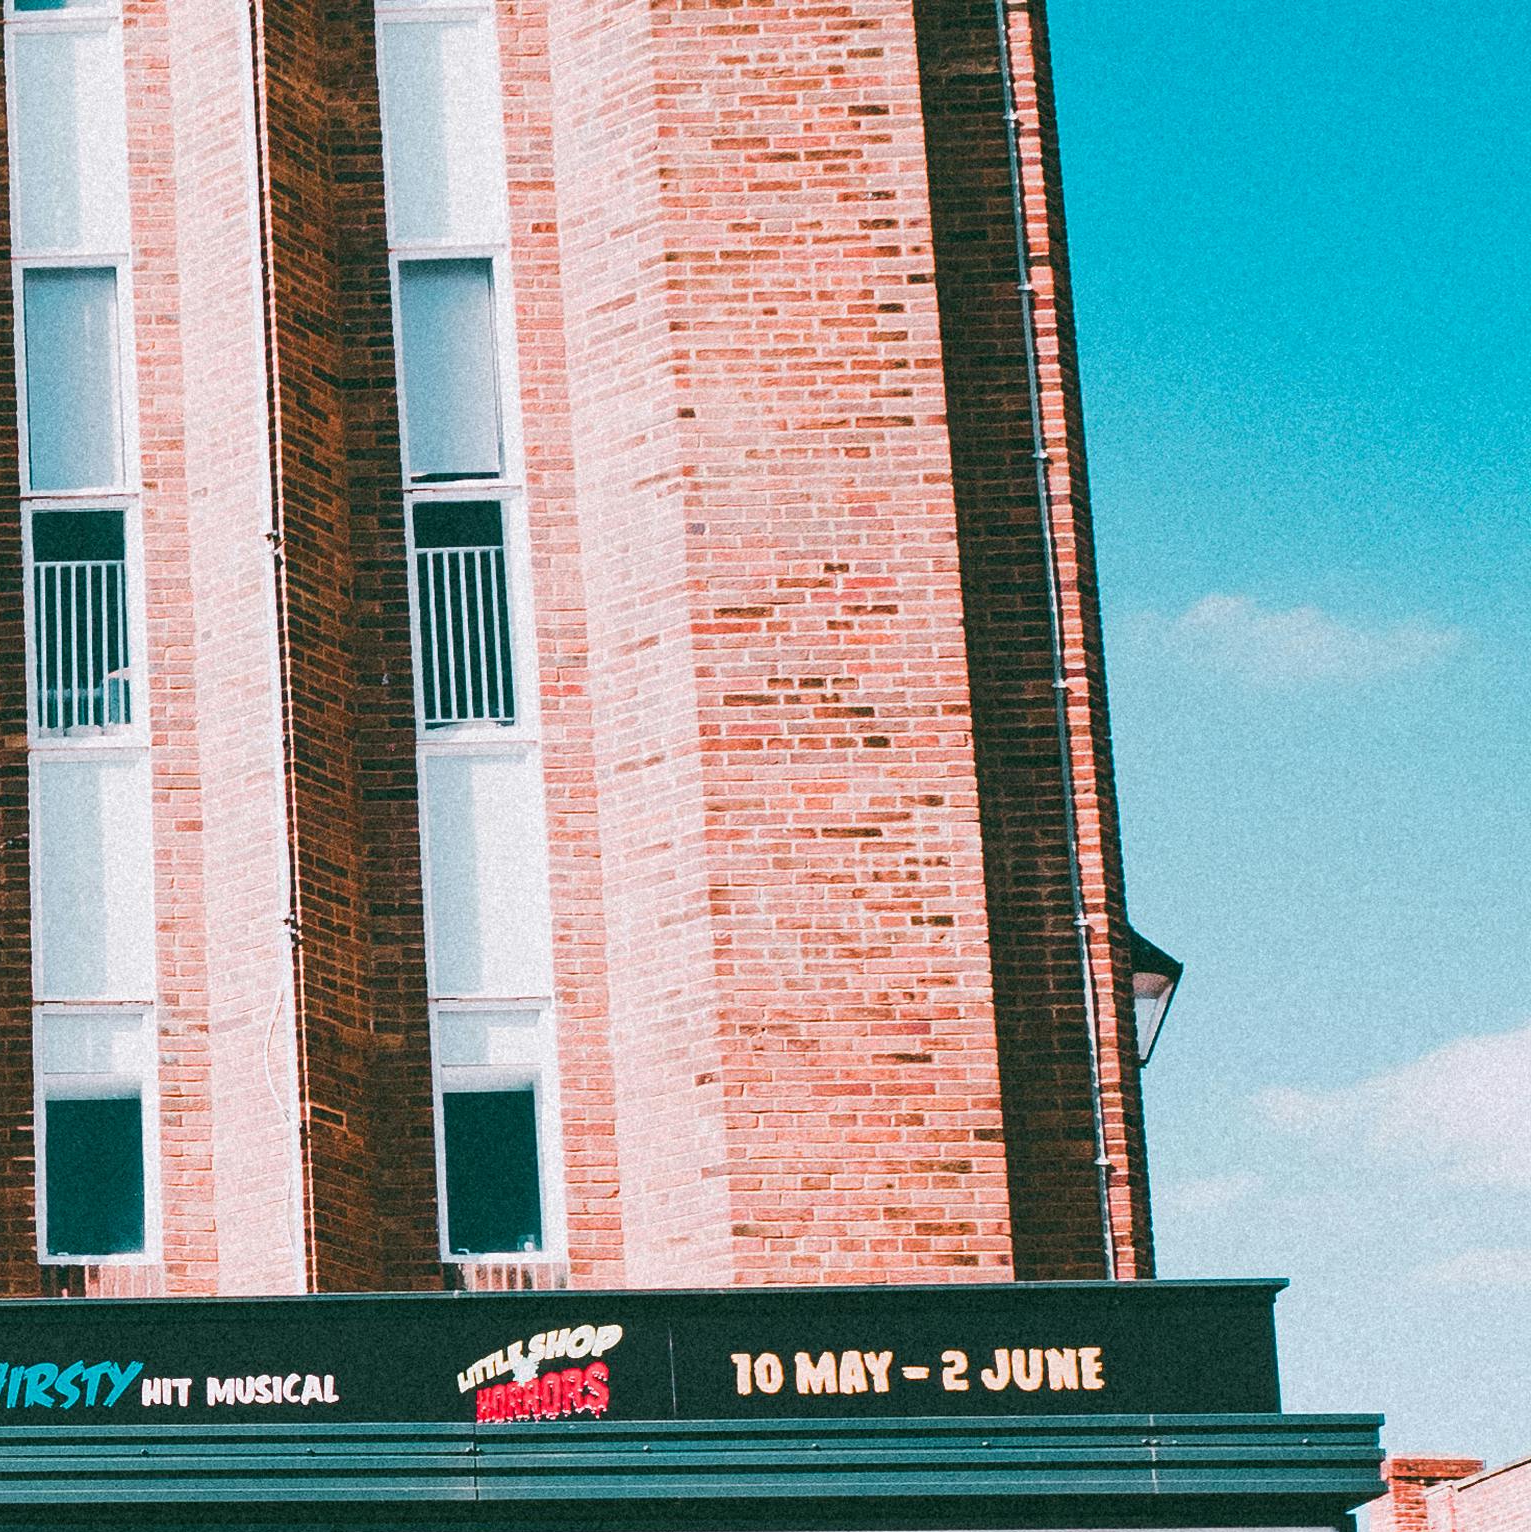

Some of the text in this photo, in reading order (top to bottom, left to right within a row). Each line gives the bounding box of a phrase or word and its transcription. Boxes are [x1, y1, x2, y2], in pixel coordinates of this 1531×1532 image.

[456, 1324, 623, 1394] LITTLE SHOP
[731, 1352, 784, 1396] 10
[795, 1350, 895, 1395] MAY
[942, 1350, 969, 1392] 2
[981, 1346, 1105, 1393] JUNE
[141, 1377, 192, 1407] HIT
[206, 1373, 340, 1406] MUSICAL
[475, 1361, 610, 1424] HORRORS
